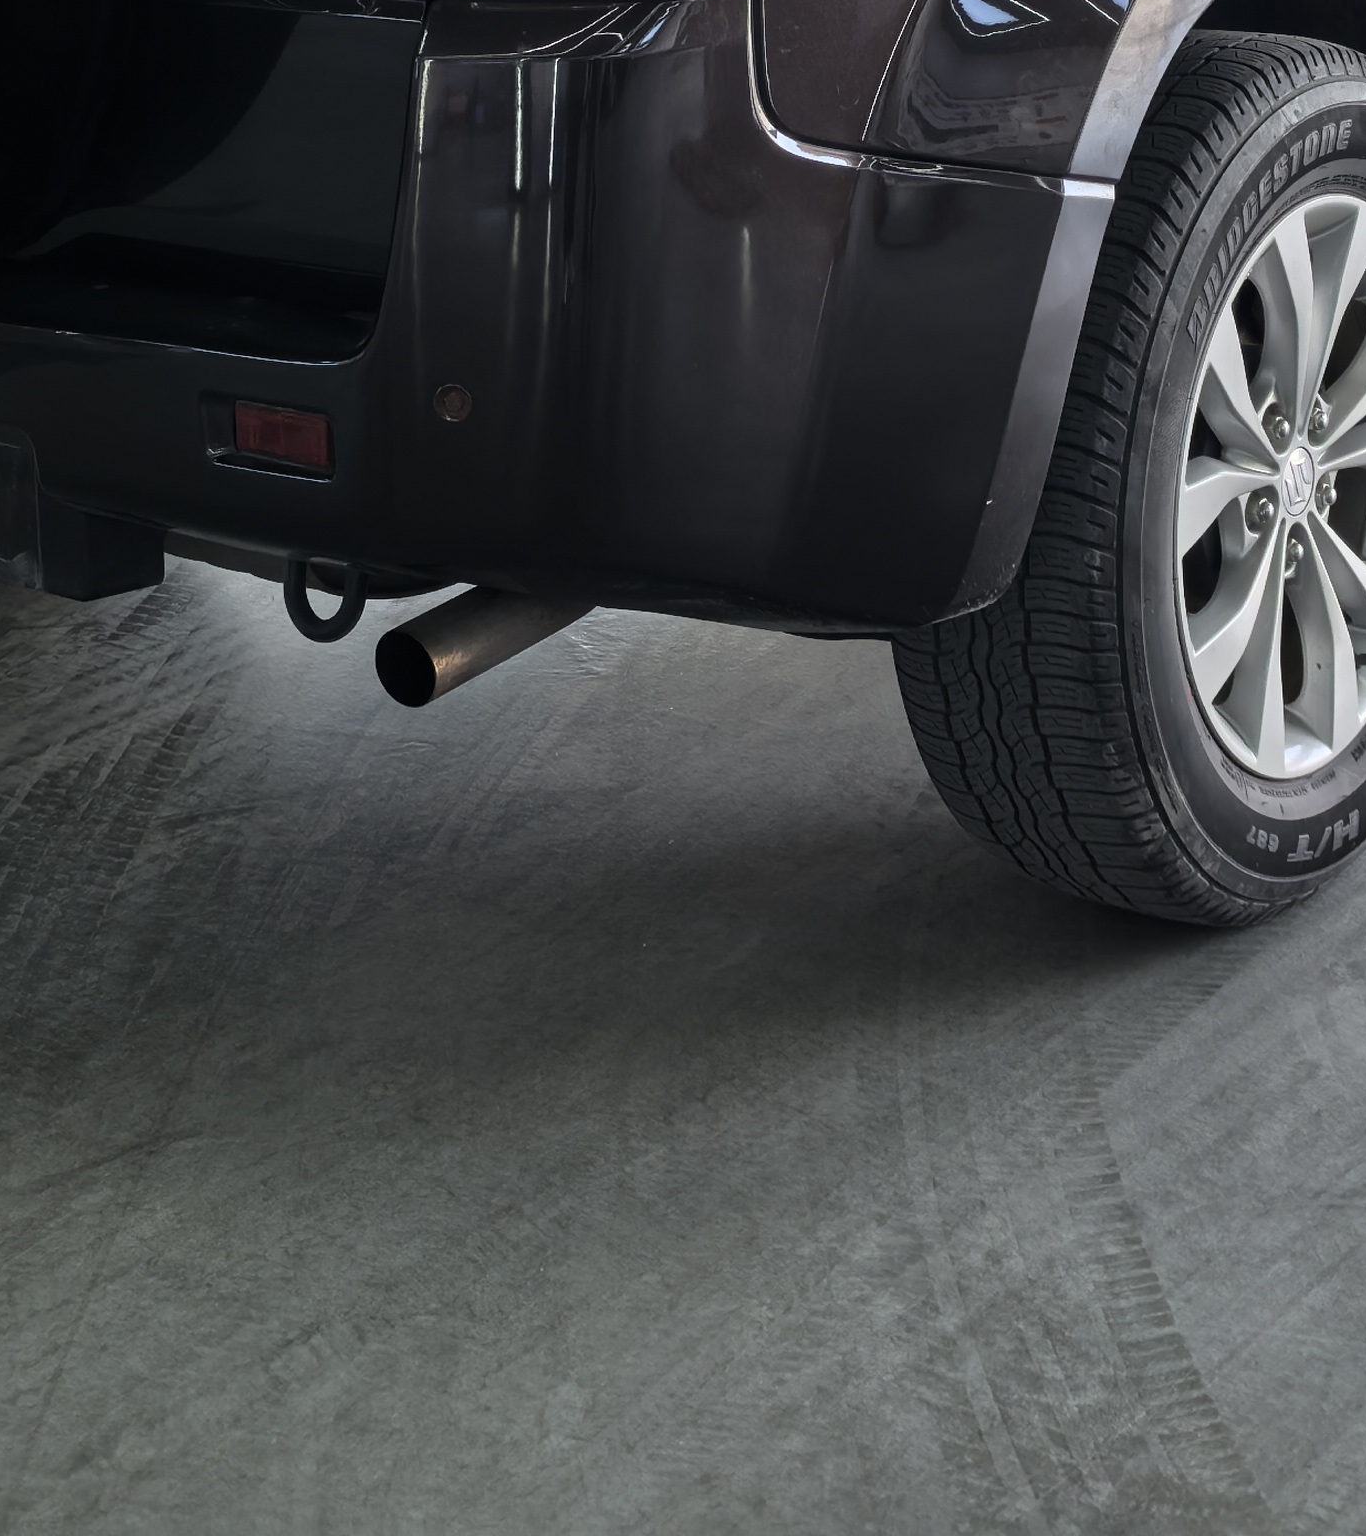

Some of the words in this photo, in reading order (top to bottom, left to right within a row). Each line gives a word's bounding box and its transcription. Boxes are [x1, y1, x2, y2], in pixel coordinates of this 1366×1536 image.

[1186, 119, 1353, 354] BRIDGESTONE
[1245, 824, 1281, 854] 687
[1285, 808, 1362, 864] H/T
